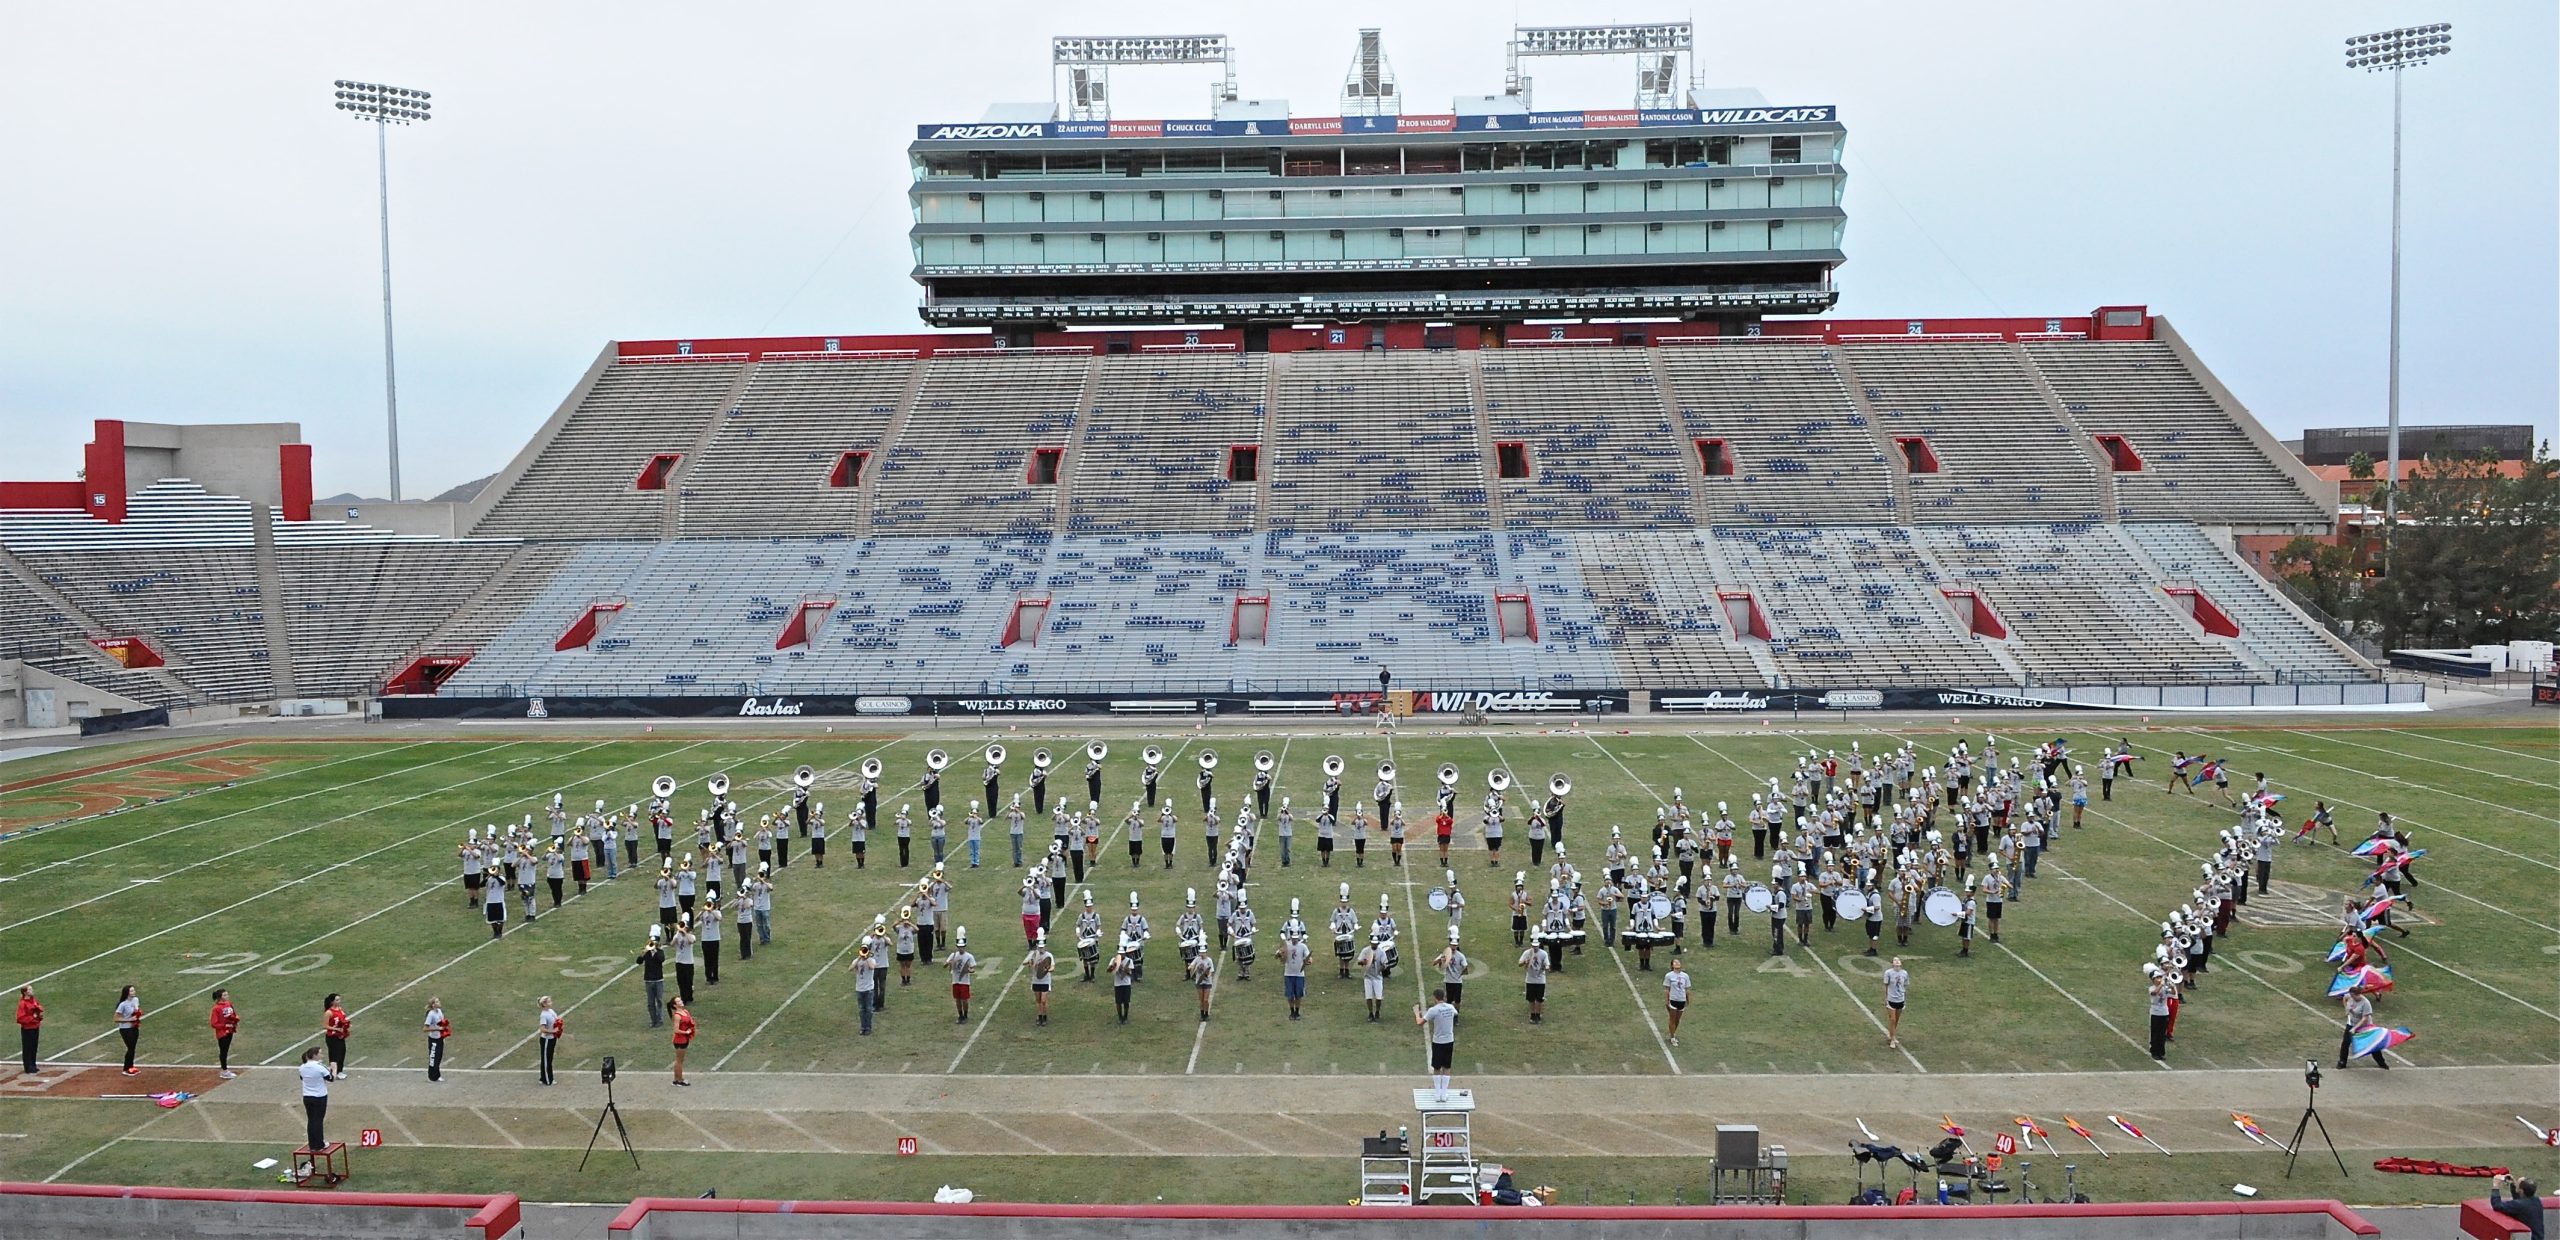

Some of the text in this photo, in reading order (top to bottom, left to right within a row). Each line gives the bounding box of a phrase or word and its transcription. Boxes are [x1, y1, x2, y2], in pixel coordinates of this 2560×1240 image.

[1671, 112, 1693, 120] CASON
[1702, 109, 1828, 124] WILDCATS
[1058, 124, 1065, 133] 22
[1172, 124, 1194, 132] CHUCK
[1195, 123, 1212, 131] CECIL
[1323, 121, 1341, 129] LEWIS
[931, 125, 1043, 139] ARIZONA
[1748, 327, 1762, 336] 23
[2048, 324, 2060, 333] 25
[1332, 333, 1344, 343] 21
[1551, 330, 1563, 339] 22
[995, 339, 1006, 348] 19
[1185, 335, 1199, 344] 20
[679, 345, 691, 354] 17
[826, 342, 838, 352] 18
[95, 496, 105, 504] 15
[348, 509, 358, 517] 16
[1938, 693, 1990, 705] WELLS
[965, 699, 1067, 710] WELLS FARGO
[176, 951, 333, 975] 20
[1757, 954, 1894, 978] 40
[362, 1130, 378, 1146] 30
[1436, 1133, 1453, 1148] 50
[899, 1138, 915, 1154] 40
[1996, 1134, 2013, 1153] 40
